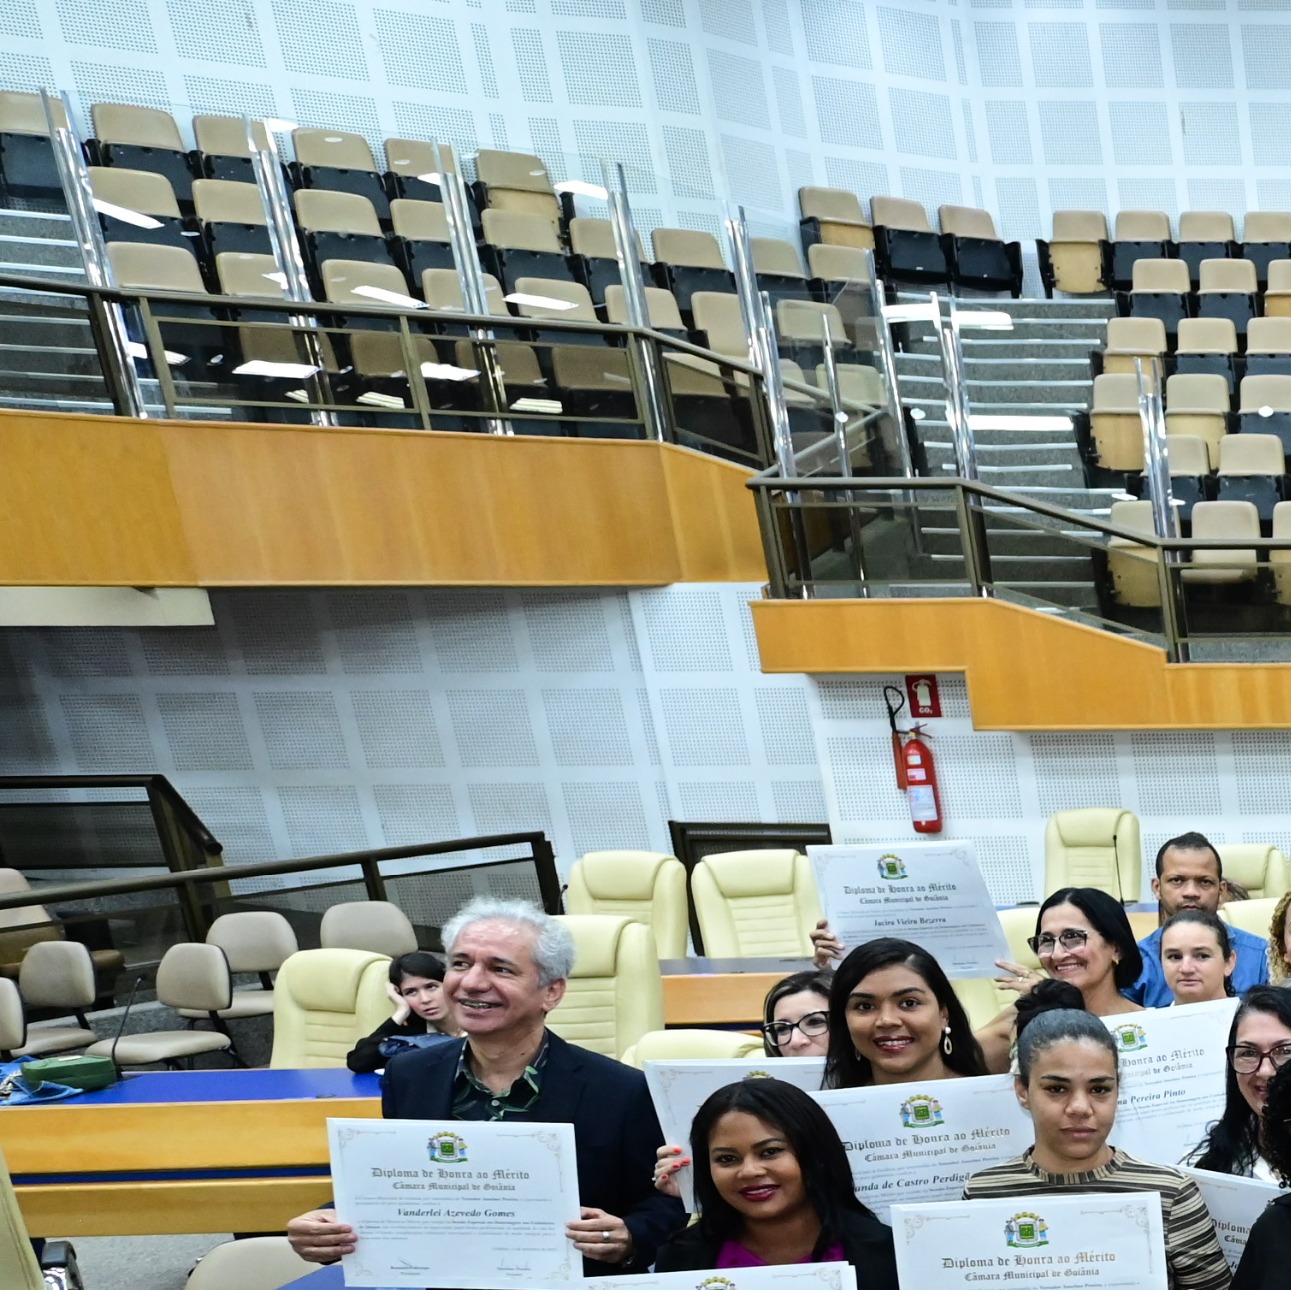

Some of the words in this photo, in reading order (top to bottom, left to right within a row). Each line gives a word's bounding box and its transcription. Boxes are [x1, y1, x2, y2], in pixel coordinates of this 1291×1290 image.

[1130, 1094, 1160, 1103] Pereira
[1163, 1090, 1185, 1098] Pinto
[371, 1168, 419, 1178] Diploma
[422, 1169, 433, 1178] de
[437, 1169, 472, 1178] Honra
[492, 1169, 529, 1180] Mérito
[882, 1181, 893, 1189] de
[897, 1179, 929, 1187] Castro
[933, 1173, 972, 1183] Perdigã
[941, 1258, 993, 1269] Diploma
[997, 1257, 1009, 1266] de
[1014, 1255, 1052, 1266] Honra
[1074, 1252, 1115, 1264] Mérito
[965, 1272, 1000, 1281] Câmara
[1004, 1270, 1048, 1280] Municipal
[1064, 1267, 1099, 1277] Goiânia
